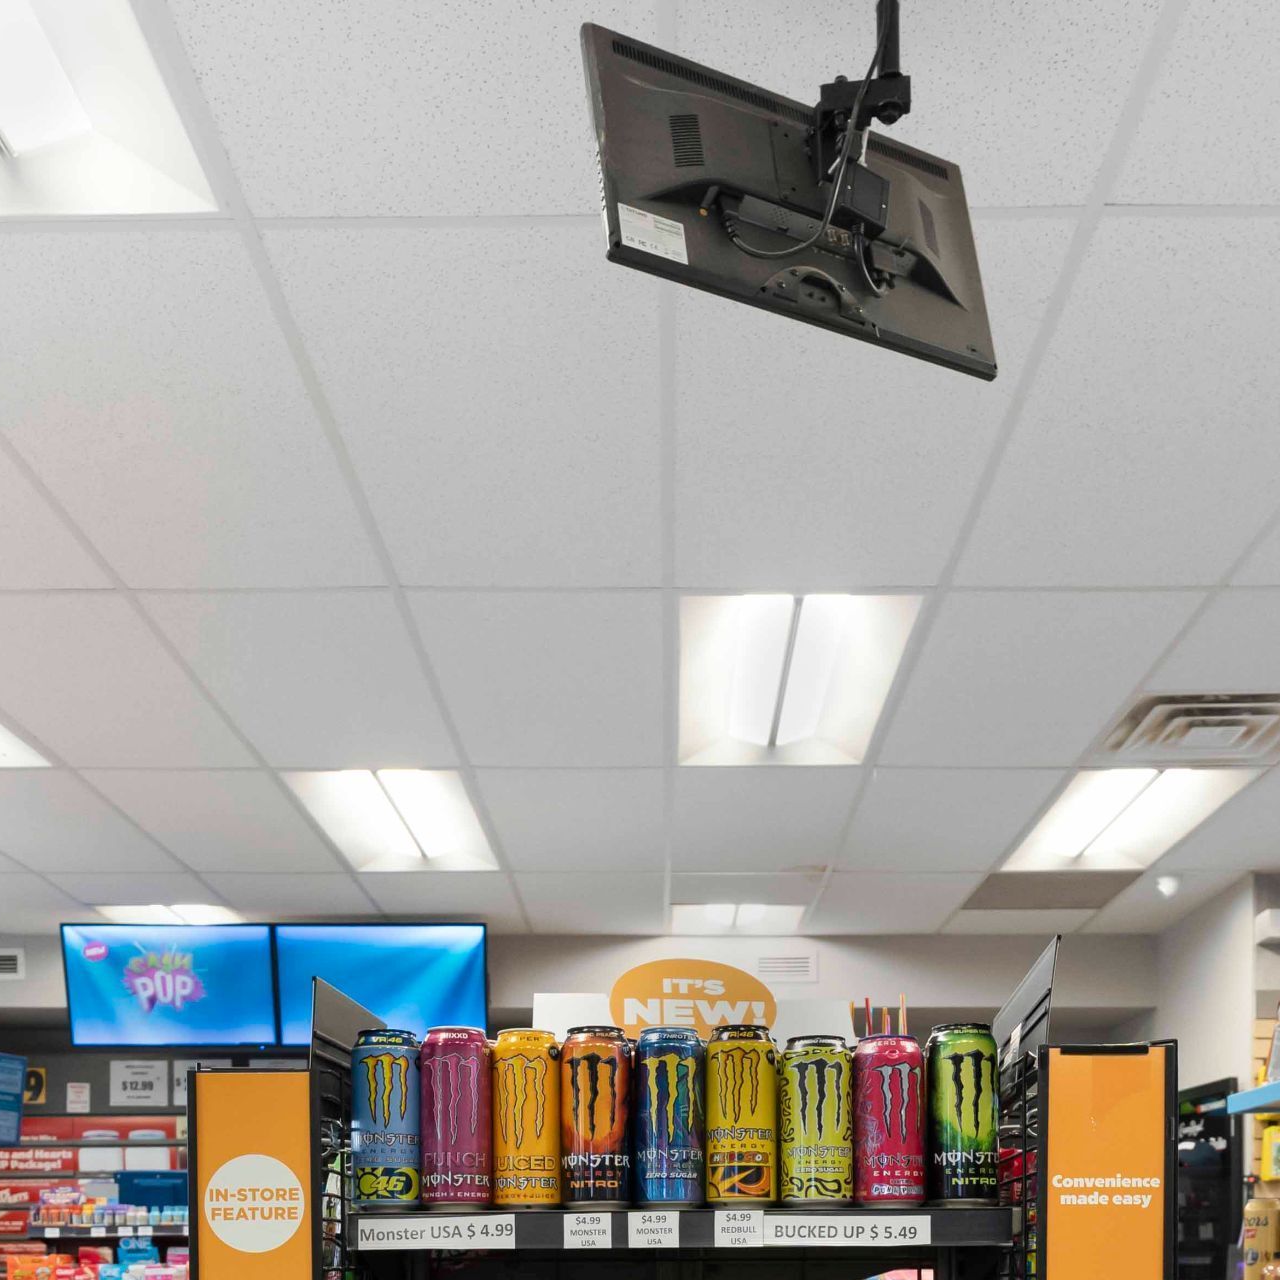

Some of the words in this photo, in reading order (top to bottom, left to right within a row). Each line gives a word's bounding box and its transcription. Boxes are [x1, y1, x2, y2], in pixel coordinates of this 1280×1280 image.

[128, 954, 193, 973] CASH
[134, 971, 194, 1003] POP
[662, 978, 726, 995] IT'S
[624, 998, 766, 1026] NEW!
[35, 1149, 72, 1159] Hearts
[425, 1152, 485, 1167] PUNCH
[561, 1152, 630, 1168] MONSTER
[422, 1171, 490, 1186] MONSTER
[570, 1180, 618, 1189] NITRO
[1052, 1174, 1161, 1190] Convenience
[209, 1188, 300, 1202] IN-STORE
[1060, 1192, 1106, 1206] made
[1110, 1194, 1152, 1208] easy
[211, 1207, 298, 1222] FEATURE
[575, 1216, 601, 1226] $4.99
[642, 1214, 667, 1225] $4.99
[726, 1213, 751, 1223] $4.99
[360, 1225, 426, 1242] Monster
[431, 1225, 462, 1239] USA
[467, 1224, 476, 1239] $
[480, 1223, 514, 1238] 4.99
[570, 1229, 607, 1237] MONSTER
[636, 1227, 673, 1236] MONSTER
[721, 1226, 757, 1234] REDBULL
[774, 1225, 838, 1239] BUCKED
[843, 1225, 865, 1239] UP
[870, 1225, 878, 1241] $
[885, 1226, 917, 1240] 5.49
[120, 1238, 152, 1249] ONE
[581, 1239, 596, 1247] USA
[647, 1237, 662, 1246] USA
[731, 1237, 748, 1246] USA
